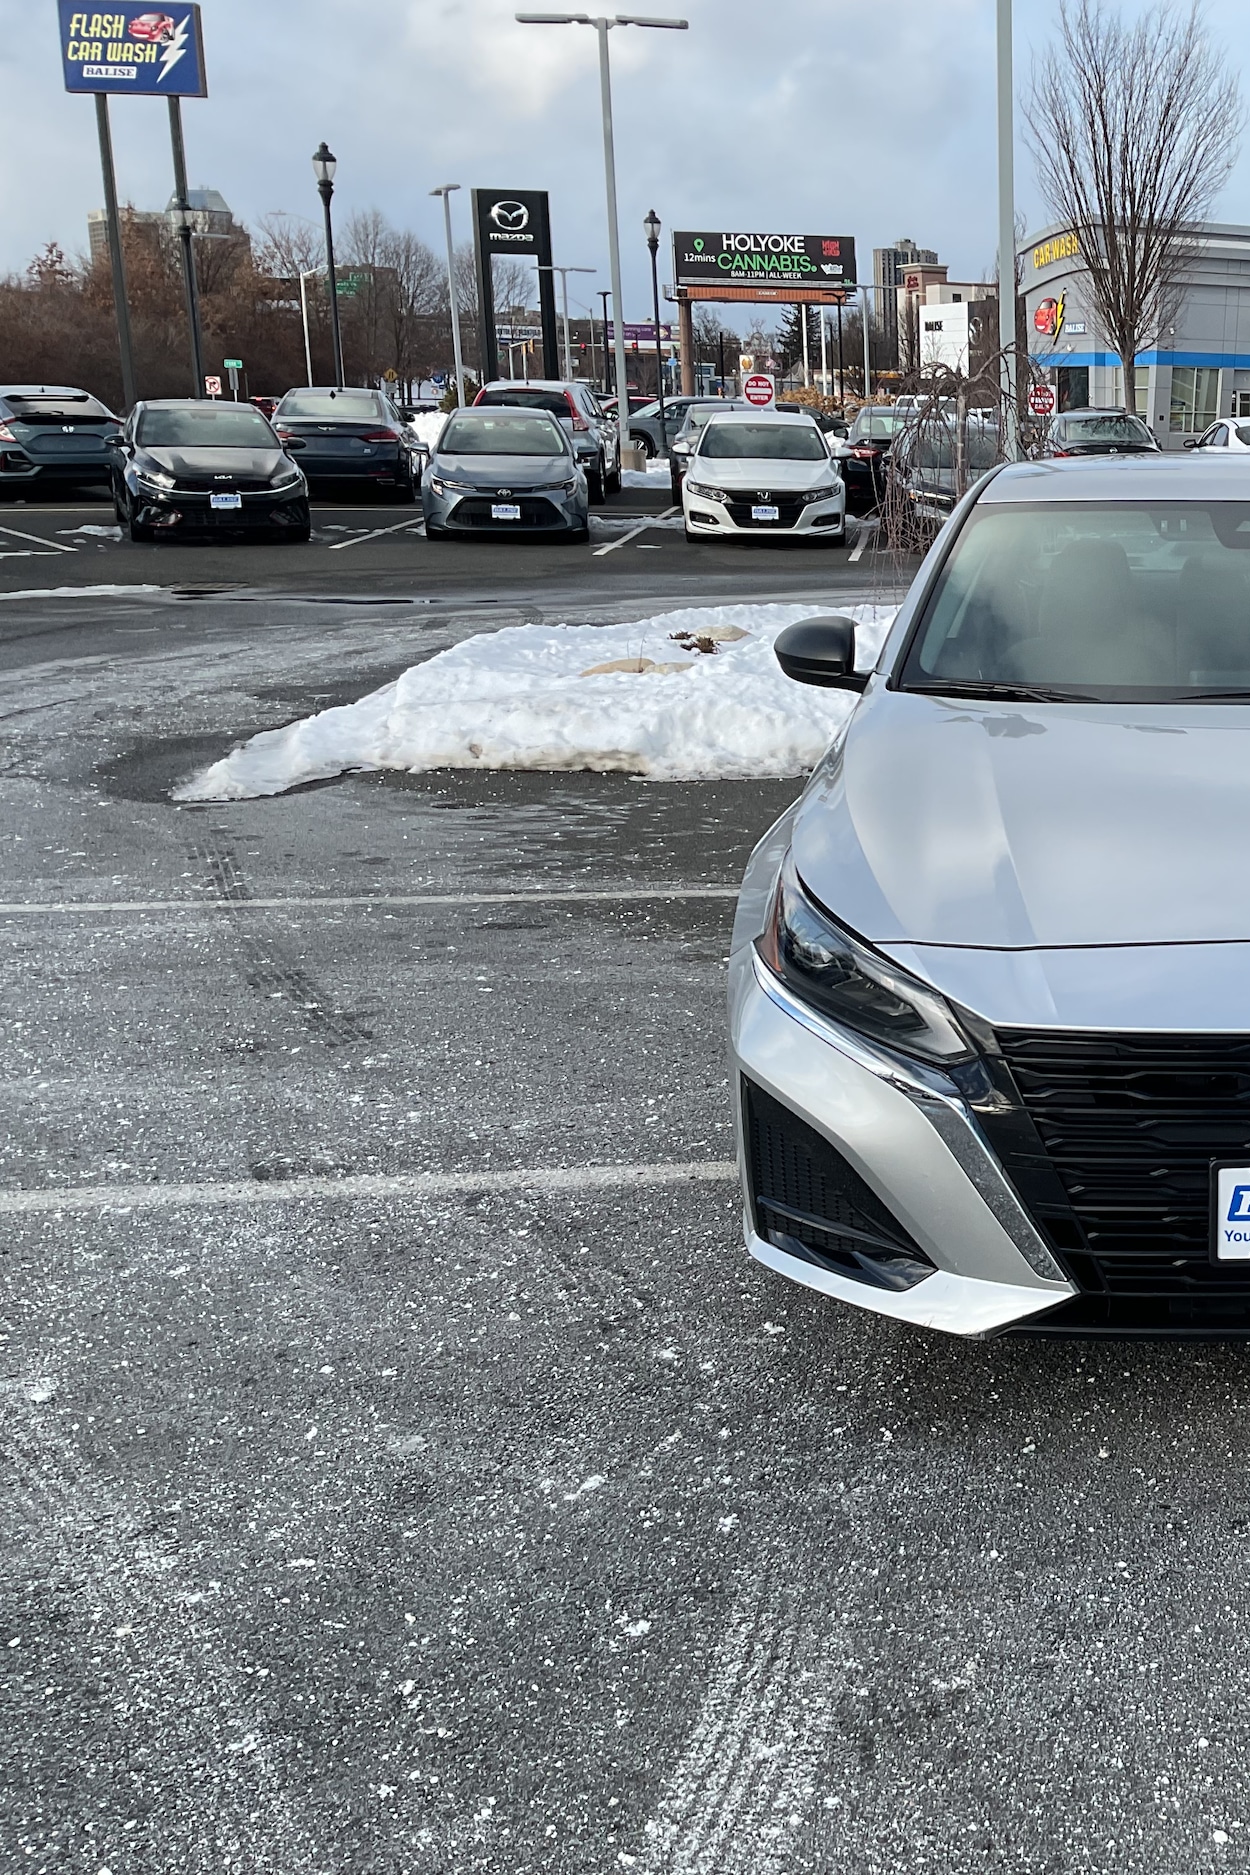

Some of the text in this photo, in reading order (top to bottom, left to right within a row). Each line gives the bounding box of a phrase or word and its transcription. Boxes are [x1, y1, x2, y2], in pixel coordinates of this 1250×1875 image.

[69, 13, 125, 39] FLASH
[67, 41, 158, 63] CAR WASH
[85, 66, 135, 77] BALISE
[722, 234, 805, 253] HOLYOKE
[684, 253, 716, 263] 12mins
[1033, 243, 1051, 269] CAR
[730, 270, 802, 280] 8AM-11PM ALL-WEEK
[1064, 323, 1086, 333] BALISE
